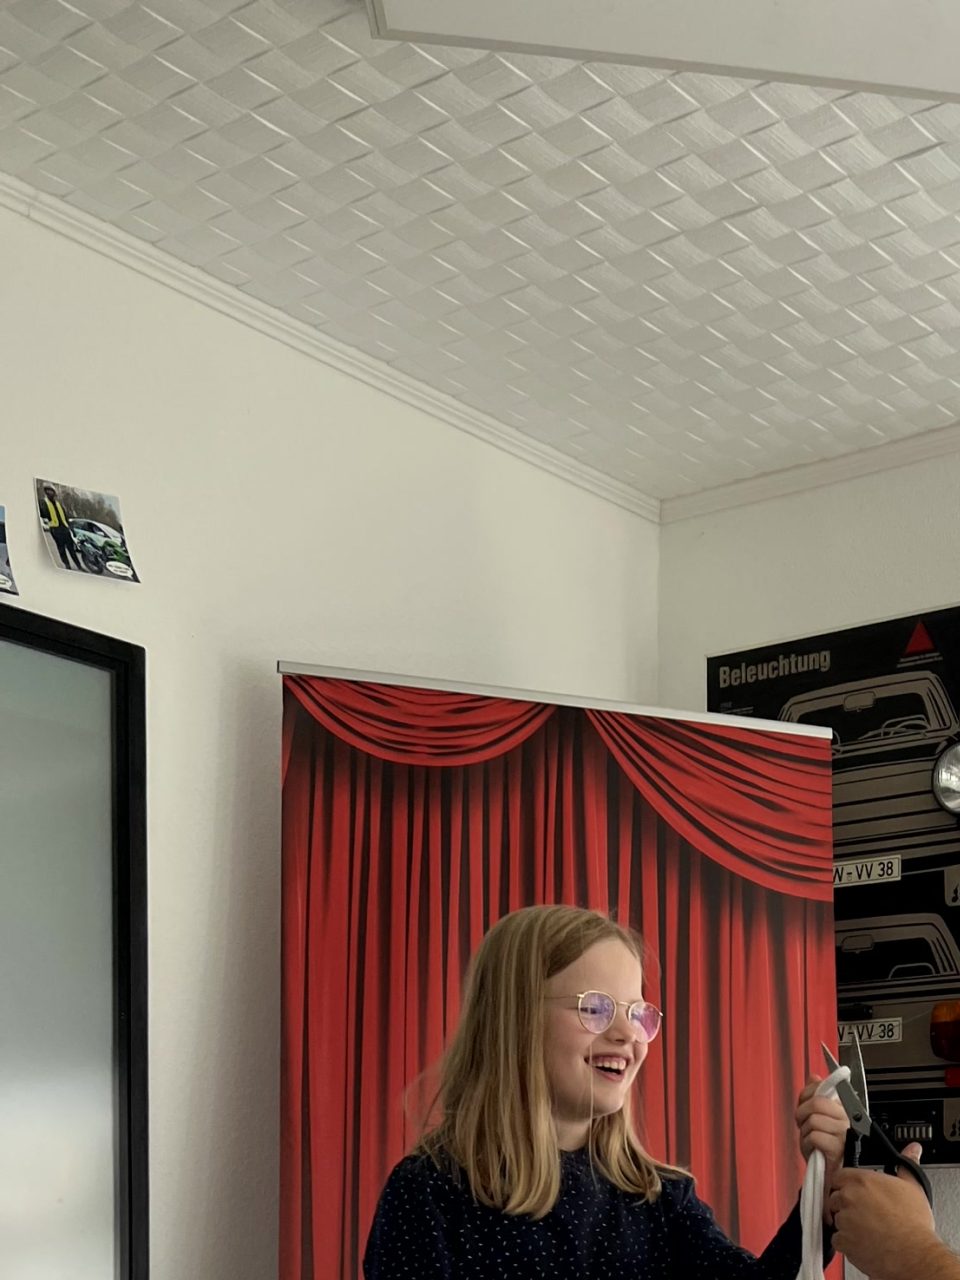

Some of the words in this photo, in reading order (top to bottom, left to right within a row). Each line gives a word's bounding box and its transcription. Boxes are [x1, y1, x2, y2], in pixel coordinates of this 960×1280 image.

[719, 650, 831, 689] Beleuchtung
[877, 861, 894, 877] 38
[878, 1023, 894, 1038] 38
